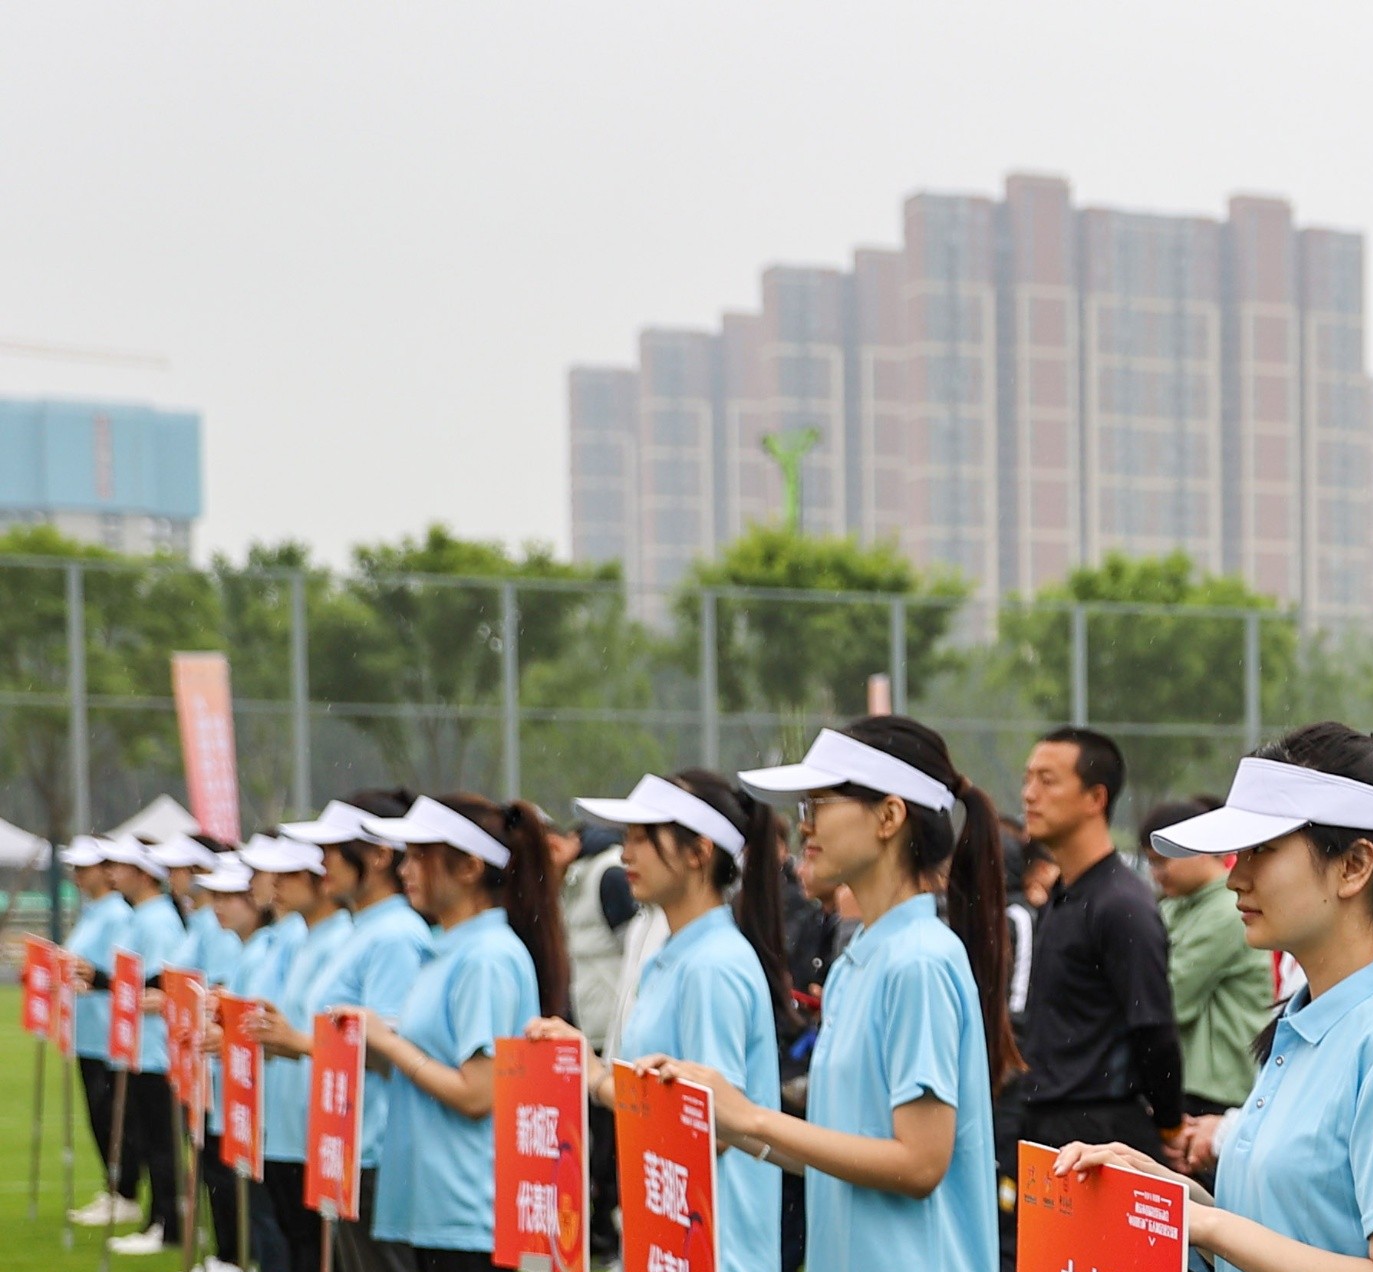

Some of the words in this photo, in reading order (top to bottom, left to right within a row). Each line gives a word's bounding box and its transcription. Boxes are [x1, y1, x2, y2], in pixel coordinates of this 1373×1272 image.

[515, 1181, 561, 1237] 代表队
[643, 1150, 691, 1228] 莲湖区
